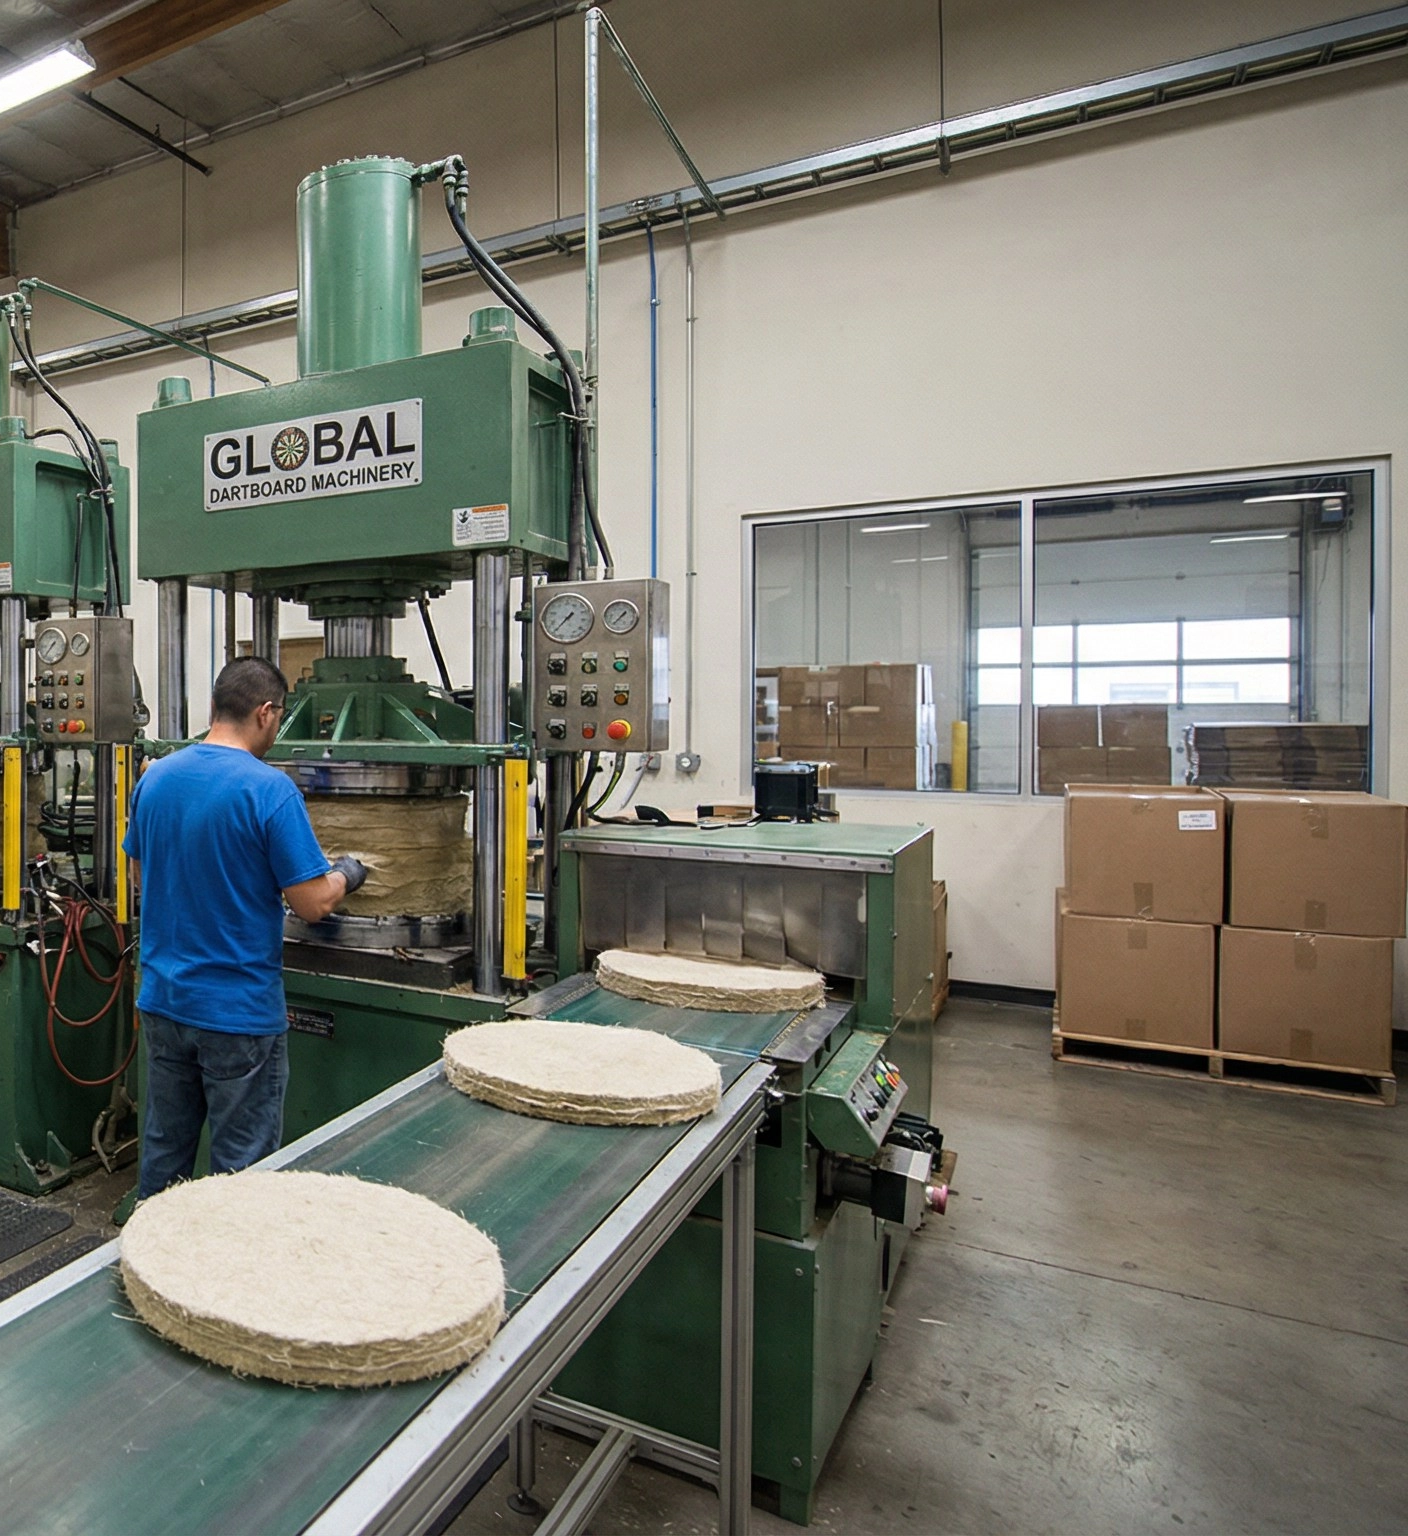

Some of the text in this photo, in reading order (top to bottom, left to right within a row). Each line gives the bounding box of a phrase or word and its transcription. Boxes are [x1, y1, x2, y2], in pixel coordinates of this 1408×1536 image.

[210, 411, 416, 480] GLOBAL
[209, 461, 416, 504] DARTBOARD MACHINERY
